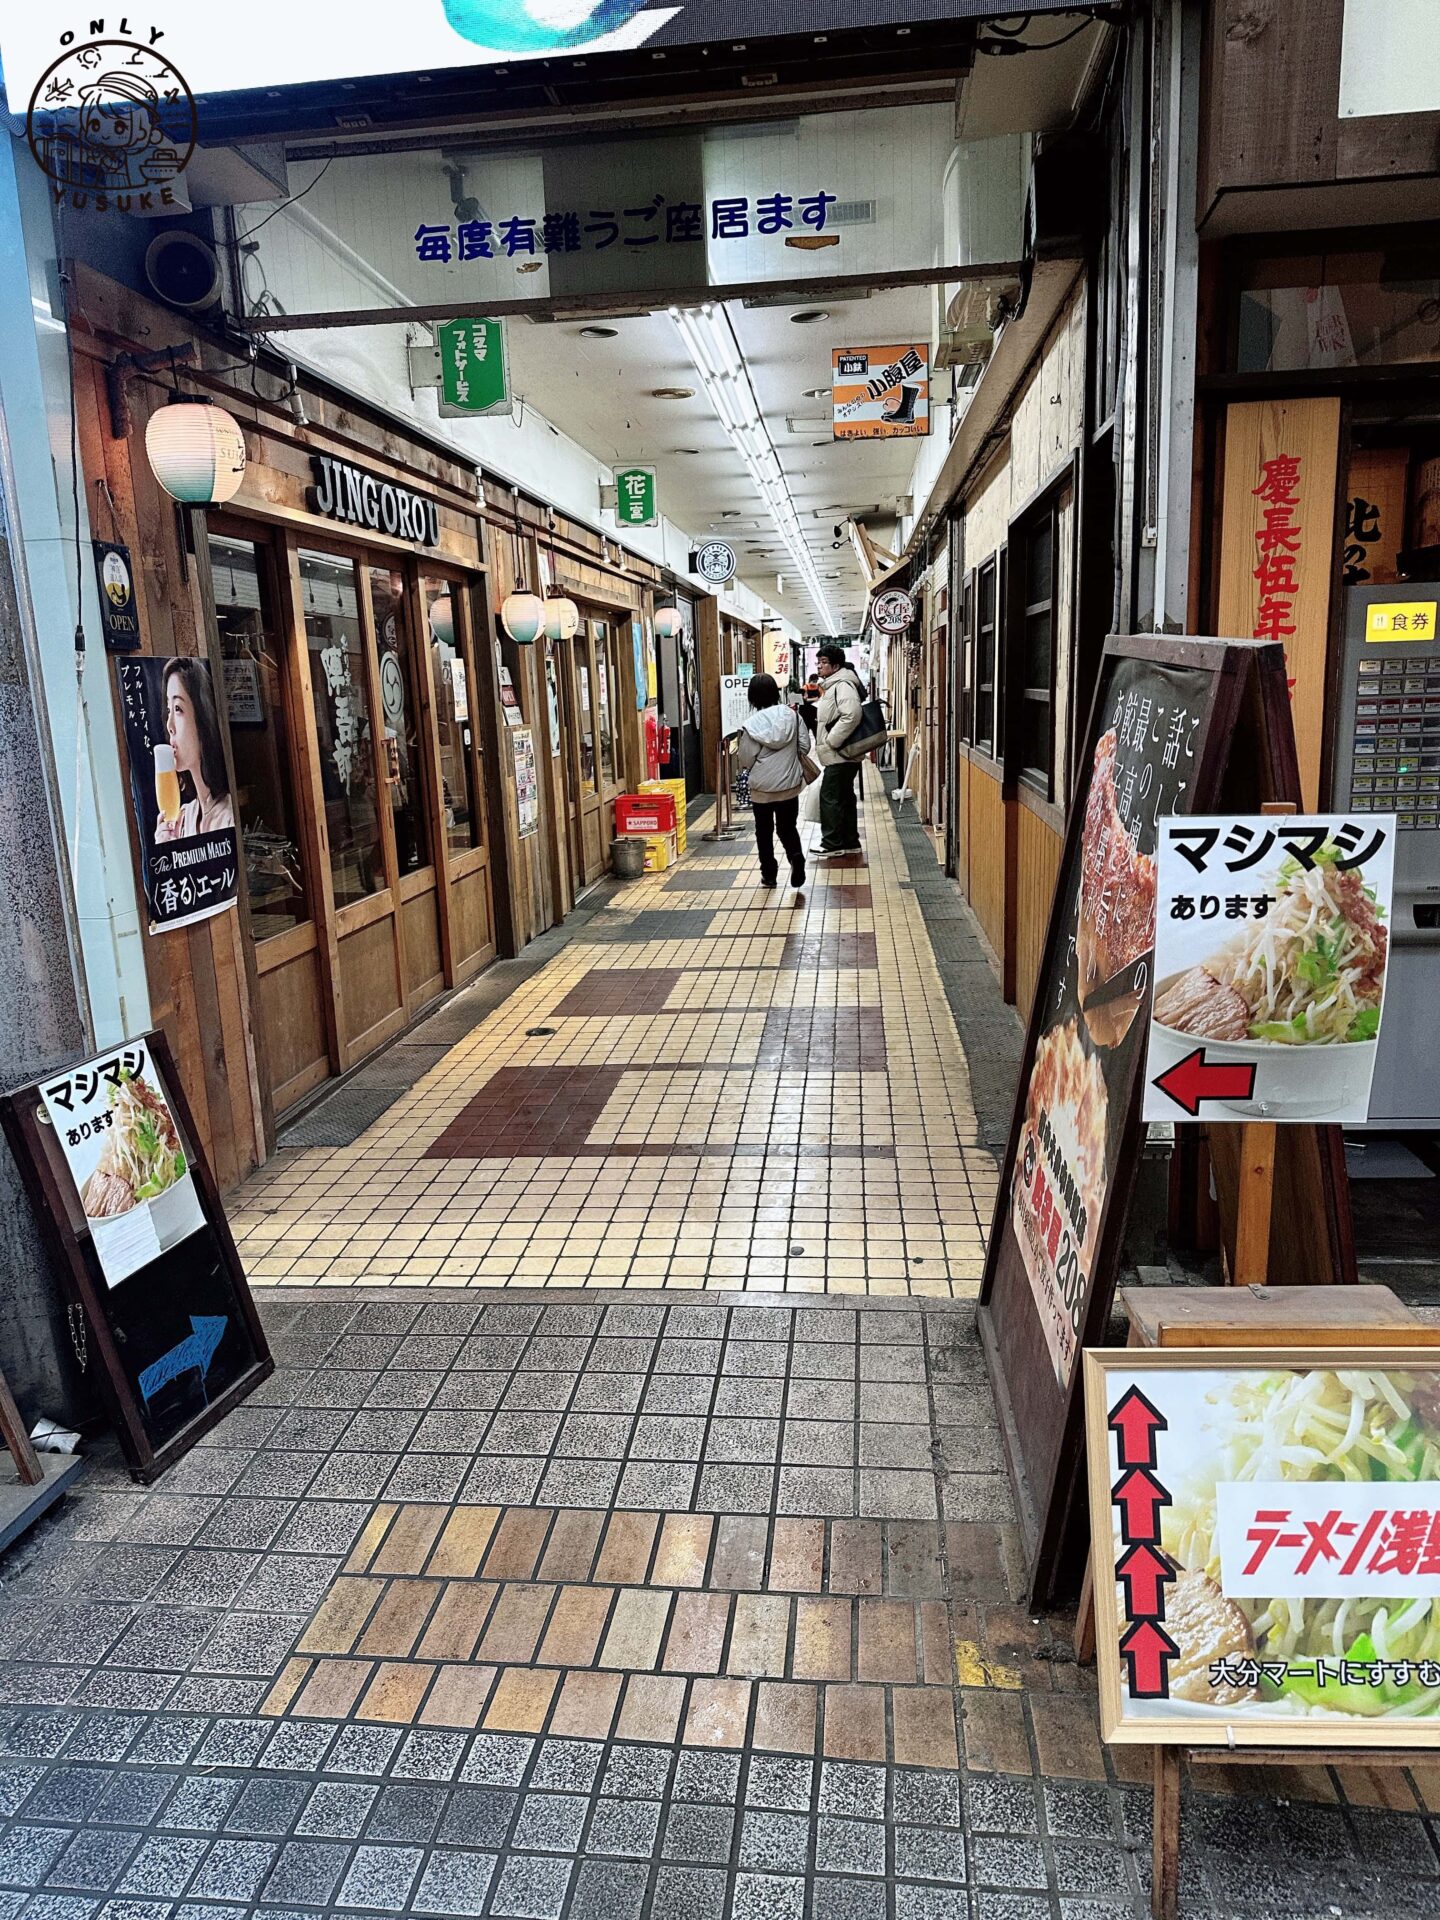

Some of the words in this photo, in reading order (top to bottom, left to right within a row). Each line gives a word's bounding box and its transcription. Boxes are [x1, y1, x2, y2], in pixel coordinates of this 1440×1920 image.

[414, 191, 837, 264] 毎度有難うご座居ます
[453, 330, 469, 402] フォトサービス
[308, 456, 440, 547] JINGOROU
[1252, 454, 1301, 701] 慶長伍年
[109, 614, 135, 631] OPEN
[1392, 613, 1429, 631] 食券
[724, 678, 750, 689] OPE
[150, 855, 173, 875] The
[171, 846, 208, 870] PREMIUM
[206, 838, 232, 860] MALT'S
[1169, 822, 1387, 874] マシマシ
[1170, 894, 1277, 920] あります
[46, 1050, 145, 1112] マシマシ
[66, 1103, 119, 1147] あります
[1056, 1229, 1087, 1337] 208
[1210, 1658, 1440, 1688] 大分マートにすすむ
